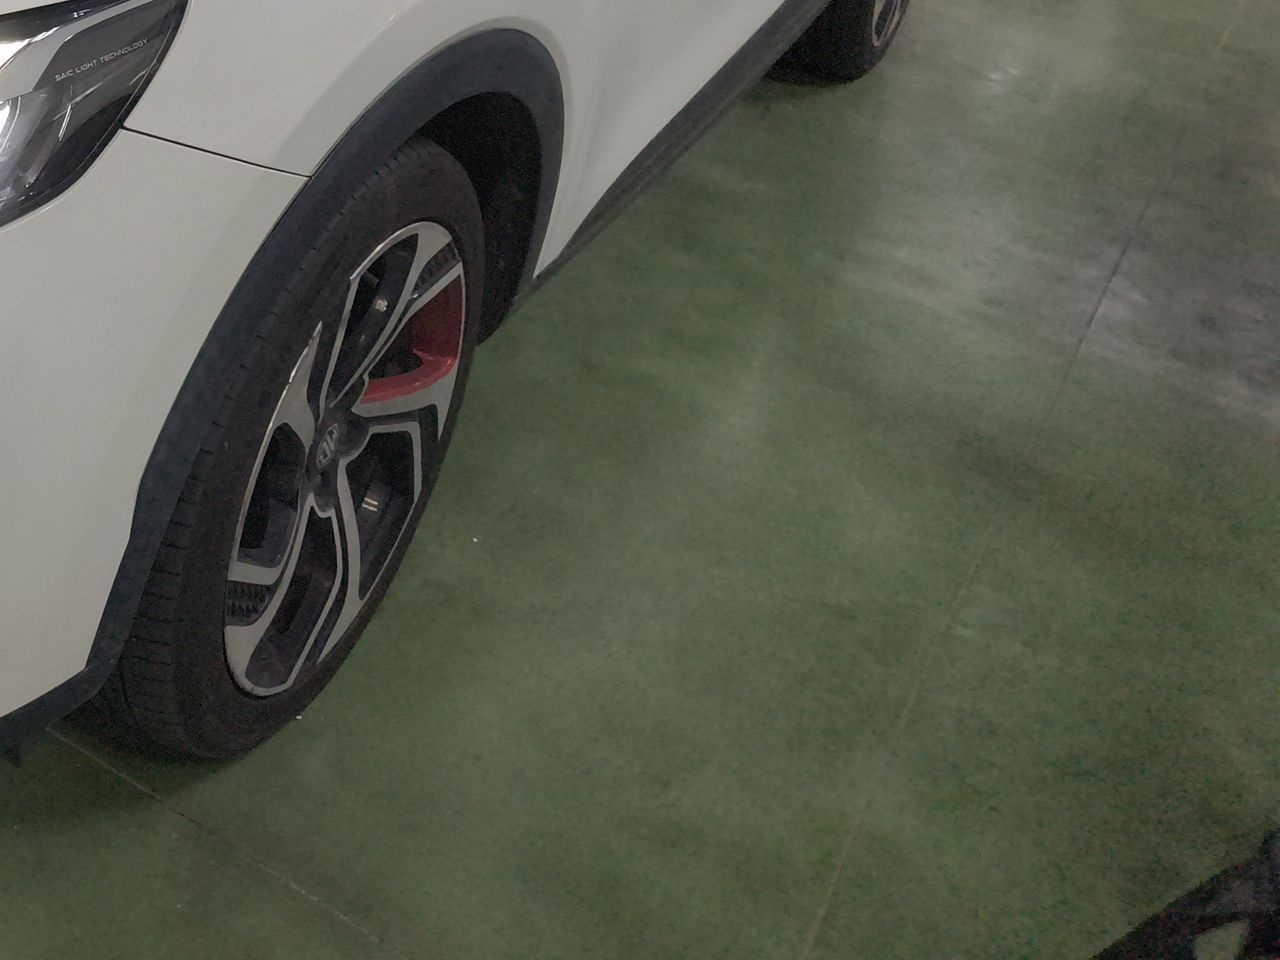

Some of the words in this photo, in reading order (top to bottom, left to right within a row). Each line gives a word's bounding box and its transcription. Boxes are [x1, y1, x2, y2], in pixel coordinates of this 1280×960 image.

[55, 69, 74, 81] SAIC
[75, 59, 97, 73] LIGHT
[99, 38, 148, 63] TECHNOLOGY
